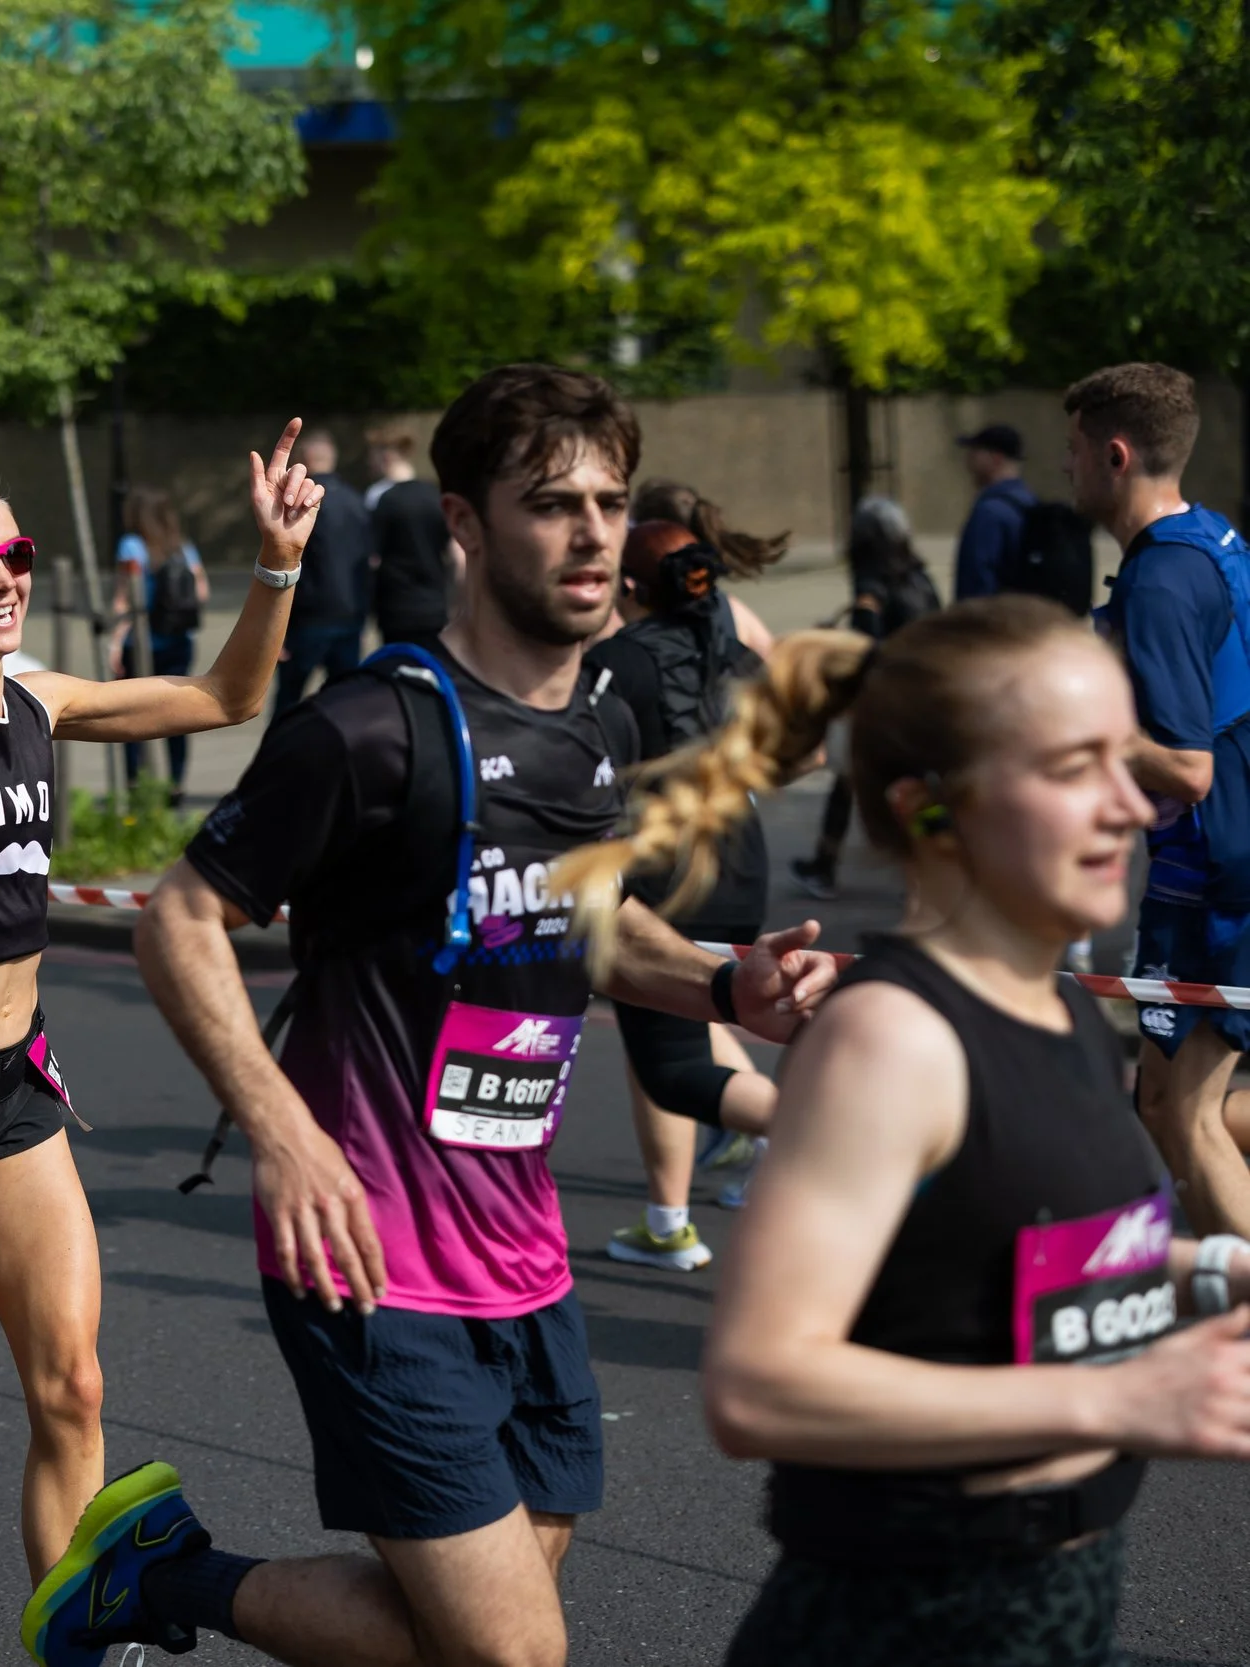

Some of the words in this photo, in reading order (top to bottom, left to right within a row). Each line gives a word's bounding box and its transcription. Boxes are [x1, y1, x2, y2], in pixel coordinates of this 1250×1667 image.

[534, 917, 569, 936] 2024
[477, 1072, 501, 1101] B
[504, 1077, 556, 1104] 16117
[454, 1114, 523, 1141] SEAN
[1051, 1305, 1090, 1355] B
